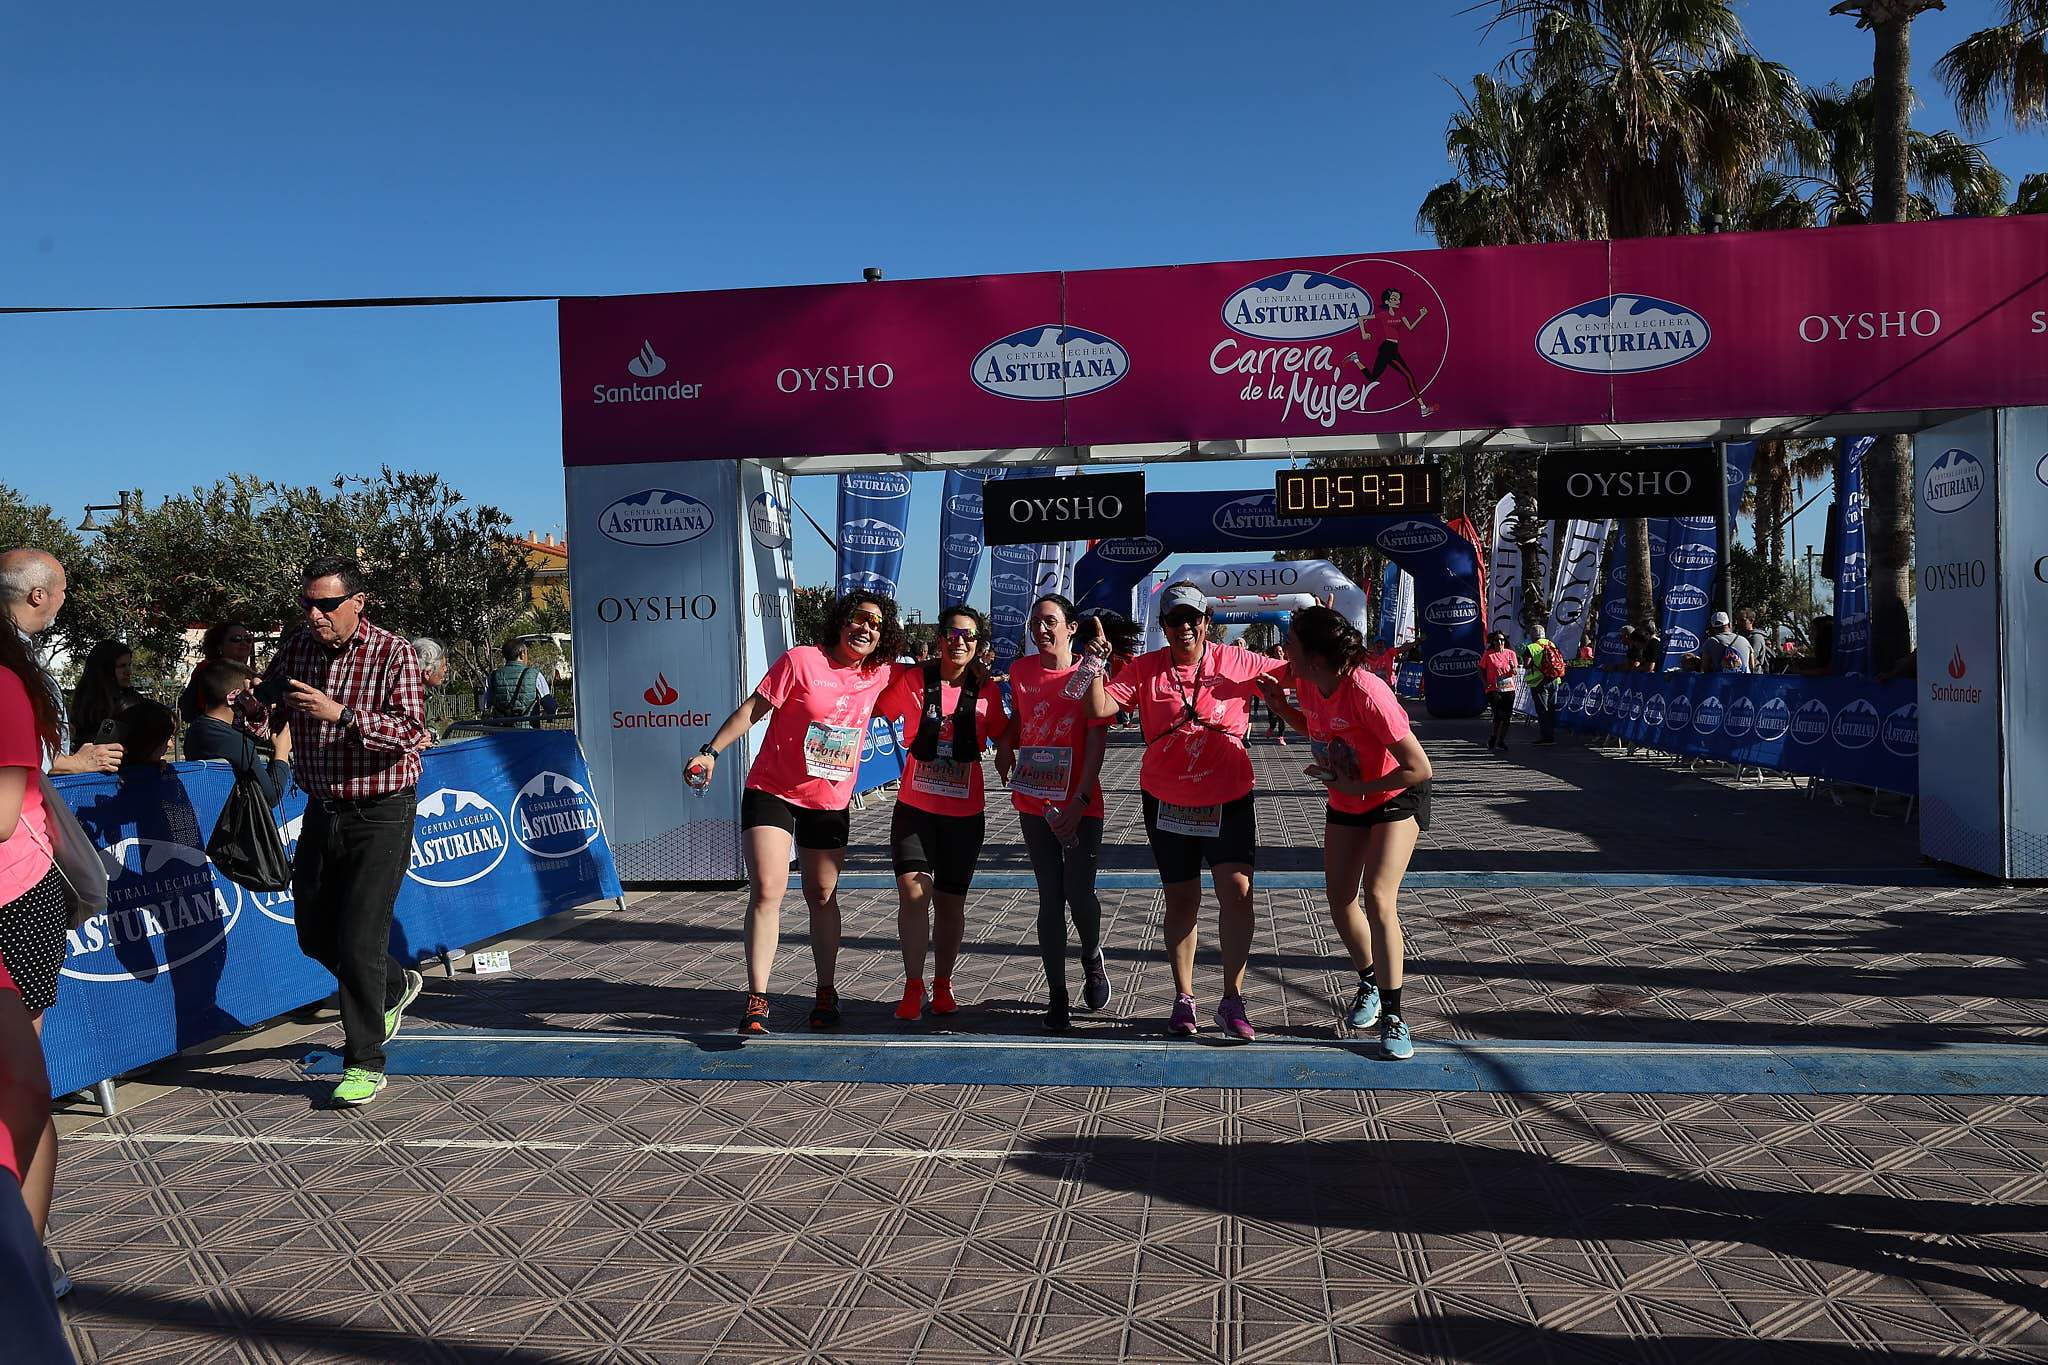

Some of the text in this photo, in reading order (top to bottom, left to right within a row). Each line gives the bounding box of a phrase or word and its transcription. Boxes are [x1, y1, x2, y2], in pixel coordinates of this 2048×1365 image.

[1234, 299, 1360, 324] ASTURIANA
[1799, 309, 1941, 342] OYSHO
[1062, 347, 1112, 358] ECHERA
[1549, 327, 1697, 355] ASTURIANA
[983, 356, 1117, 383] ASTURIANA
[1210, 339, 1333, 375] Carrera
[777, 363, 894, 393] OYSHO
[594, 380, 702, 404] Santander
[1240, 367, 1379, 427] de la Mujer
[1567, 470, 1691, 498] OYSHO
[1927, 475, 1980, 501] ASTURIANA
[1009, 495, 1123, 523] OYSHO
[607, 512, 706, 533] ASTURIANA
[1102, 544, 1158, 555] ASTURIANA
[1383, 534, 1444, 546] ASTURIANA
[1211, 567, 1298, 588] OYSHO
[1925, 560, 1985, 591] OYSHO
[597, 594, 717, 623] OYSHO
[753, 593, 789, 619] OYSHO
[1931, 682, 1981, 704] Santander
[613, 710, 712, 728] Santander
[421, 812, 494, 836] CENTRAL LECHERA
[520, 808, 597, 841] ASTURIANA
[410, 825, 503, 870] ASTURIANA
[156, 871, 217, 893] LECHERA
[64, 887, 232, 958] ASTURIANA
